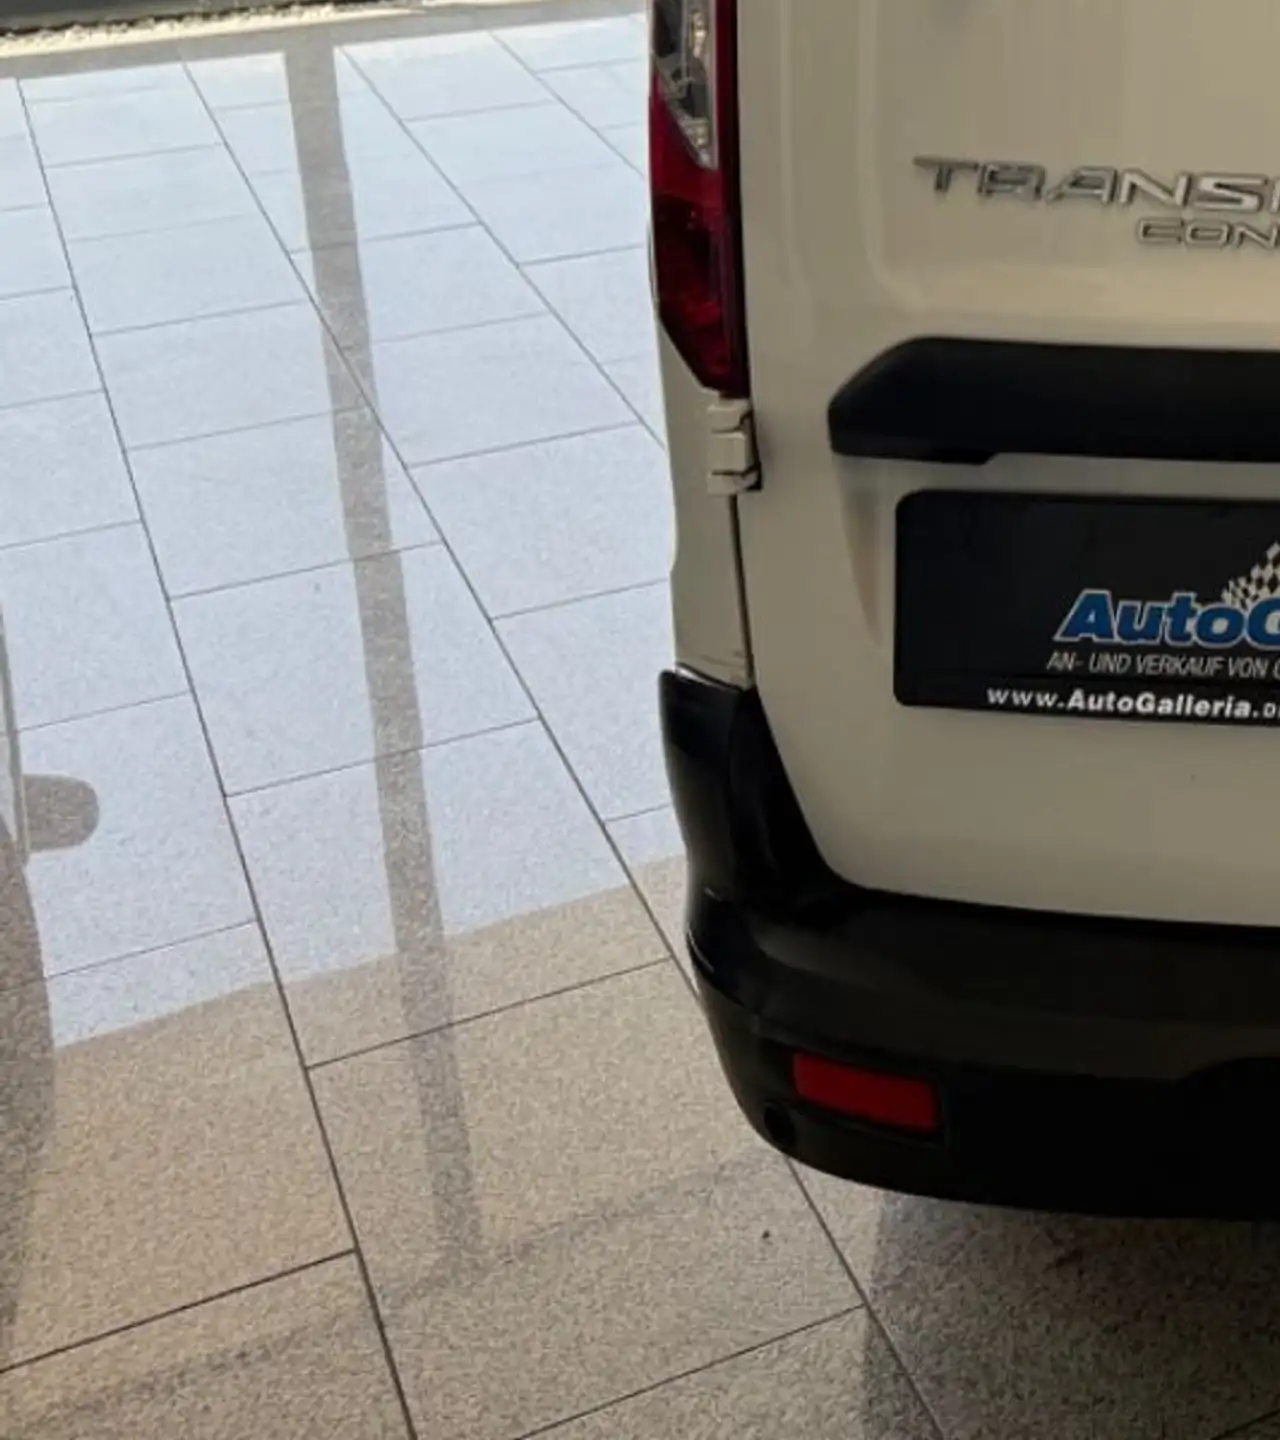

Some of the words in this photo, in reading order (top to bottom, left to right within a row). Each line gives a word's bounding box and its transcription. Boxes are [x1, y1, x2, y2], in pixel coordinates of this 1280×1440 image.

[1046, 650, 1083, 672] AN-
[1088, 652, 1132, 674] UND
[1134, 654, 1225, 678] VERKAUF
[1226, 657, 1270, 680] VON
